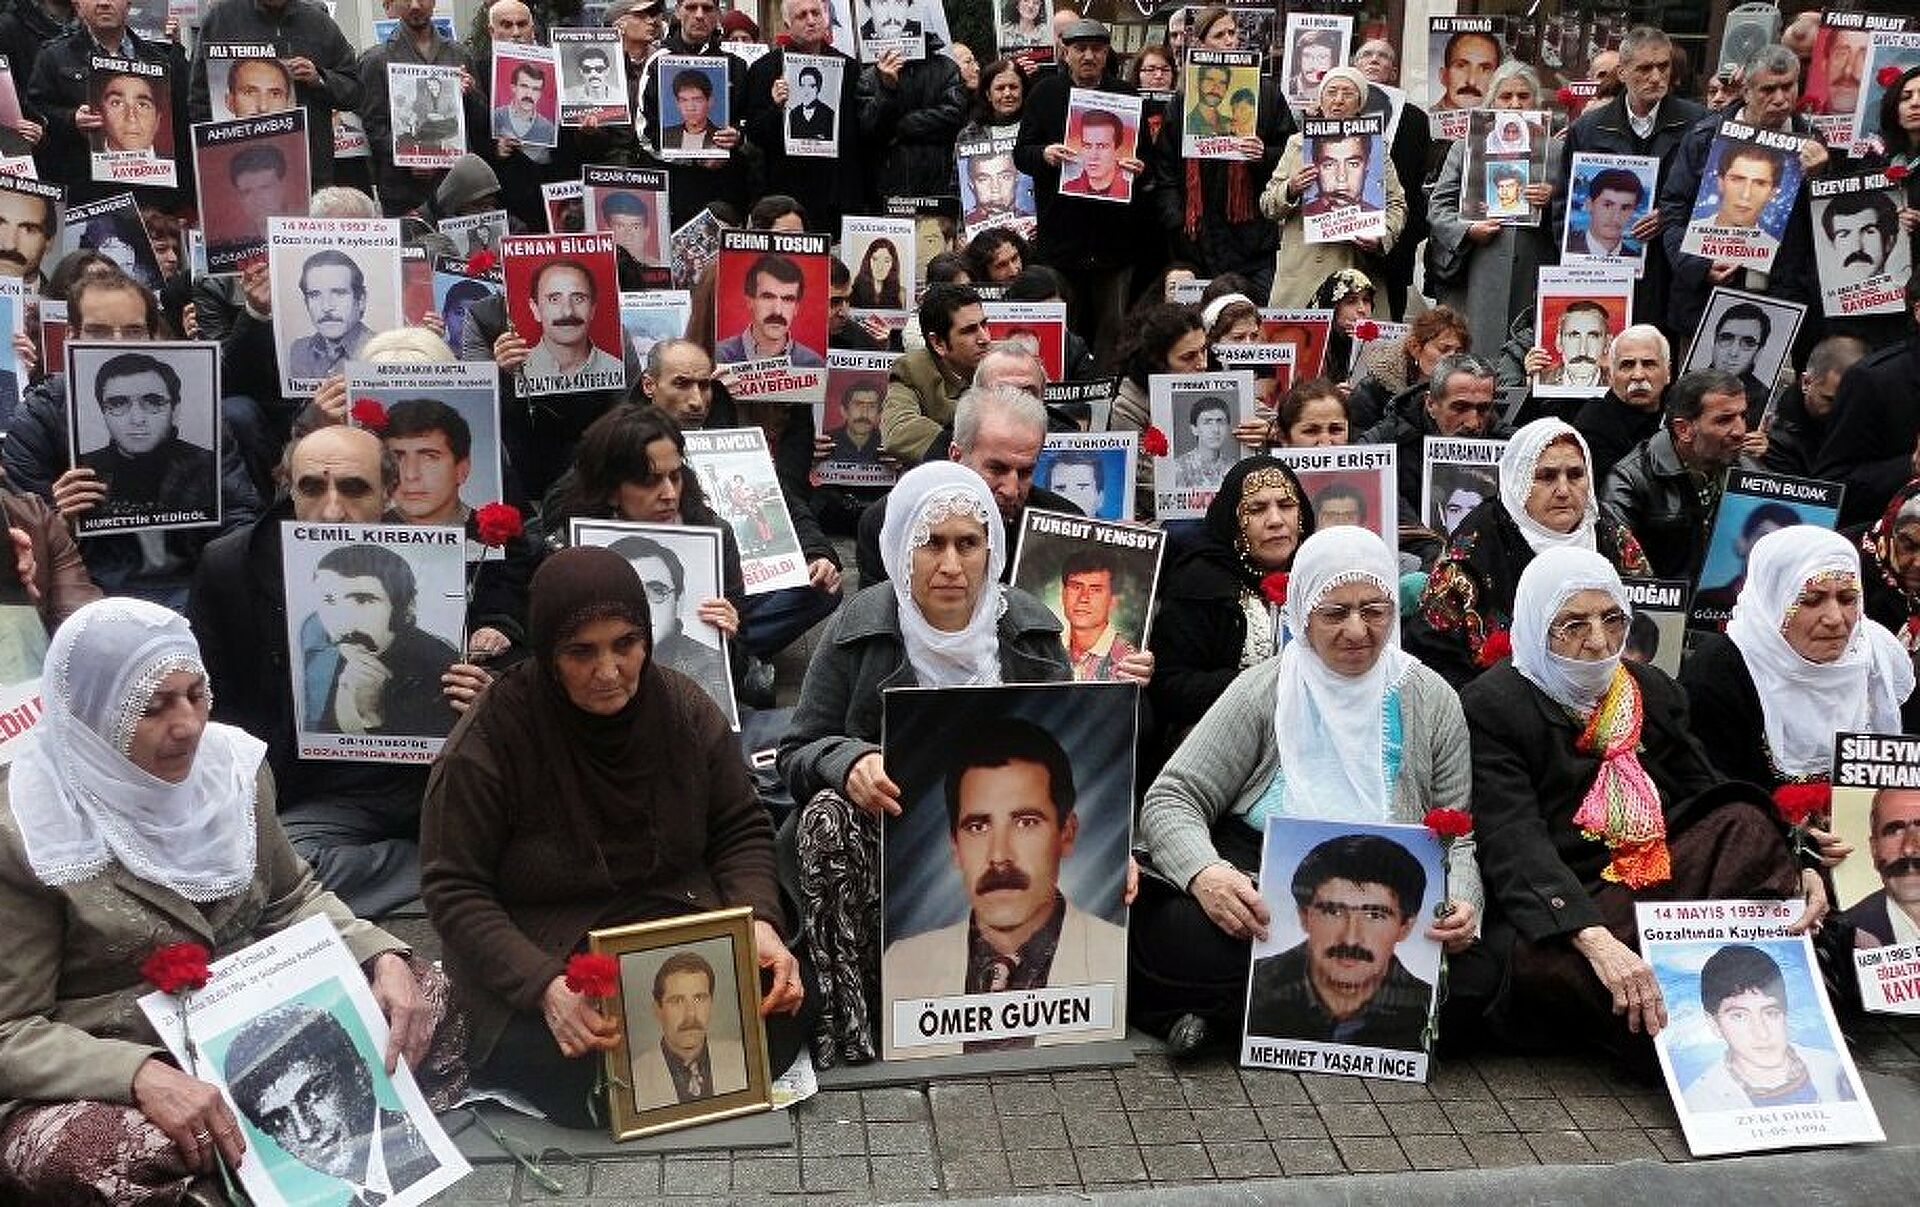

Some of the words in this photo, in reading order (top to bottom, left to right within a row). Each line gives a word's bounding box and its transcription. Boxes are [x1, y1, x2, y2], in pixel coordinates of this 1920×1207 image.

[207, 123, 252, 141] AHMET
[1756, 129, 1807, 151] AKSOY
[504, 240, 556, 257] KENAN
[561, 237, 613, 254] BİLGİN
[774, 235, 824, 253] TOSUN
[1336, 452, 1391, 470] ERİŞTİ
[1782, 482, 1829, 501] BUDAK
[294, 526, 355, 542] CEMİL
[363, 530, 458, 545] KIRBAYIR
[1031, 516, 1092, 539] TURGUT
[1653, 909, 1672, 920] 14
[918, 1002, 993, 1037] ÖMER
[1001, 994, 1091, 1030] GÜVEN
[1250, 1046, 1318, 1067] MEHMET
[1323, 1052, 1374, 1073] YAŞAR
[1378, 1053, 1416, 1077] İNCE
